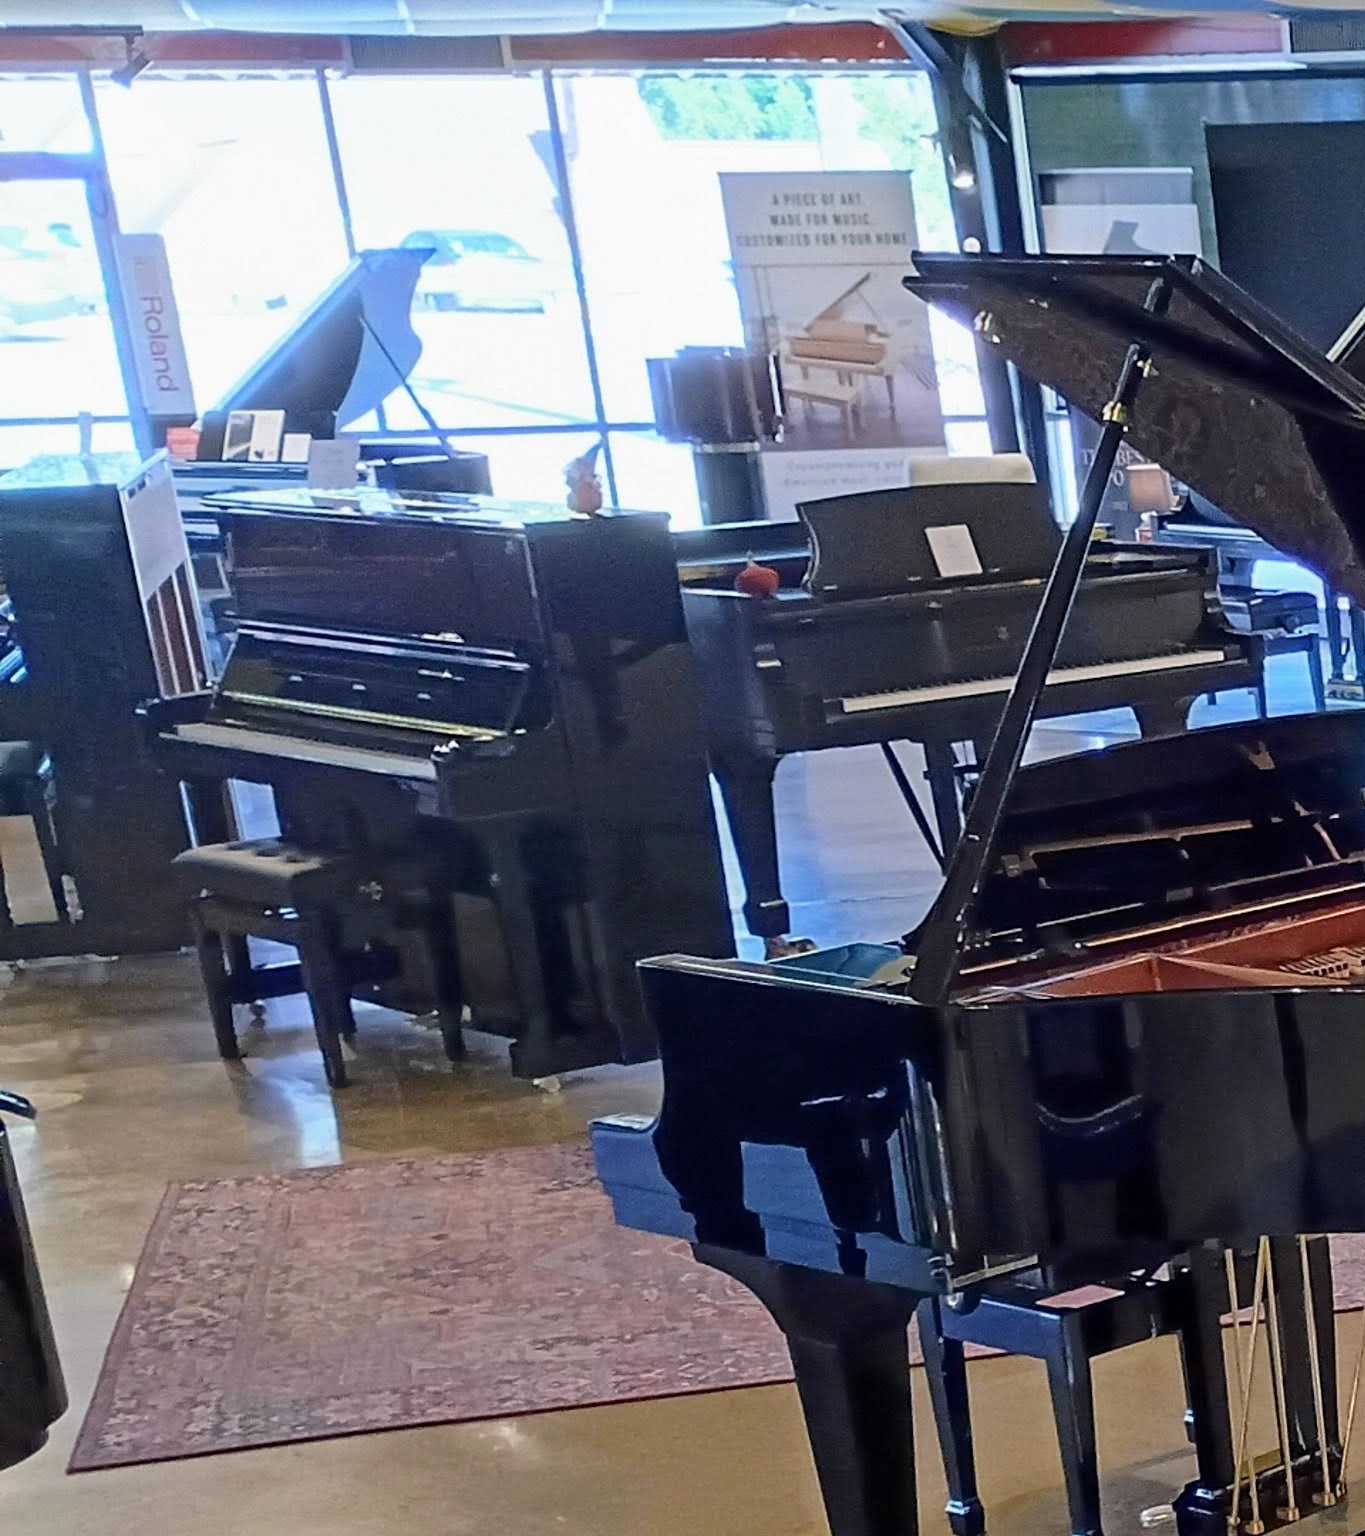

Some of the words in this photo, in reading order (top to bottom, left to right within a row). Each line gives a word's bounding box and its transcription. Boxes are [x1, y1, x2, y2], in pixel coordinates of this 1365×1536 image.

[772, 193, 780, 206] A
[783, 193, 817, 206] PIECE
[821, 193, 835, 206] OF
[770, 213, 802, 226] MADE
[806, 213, 828, 226] FOR
[736, 233, 811, 248] CUSTOMIZED
[815, 233, 837, 247] FOR
[841, 233, 872, 246] YOUR
[139, 295, 180, 393] Roland
